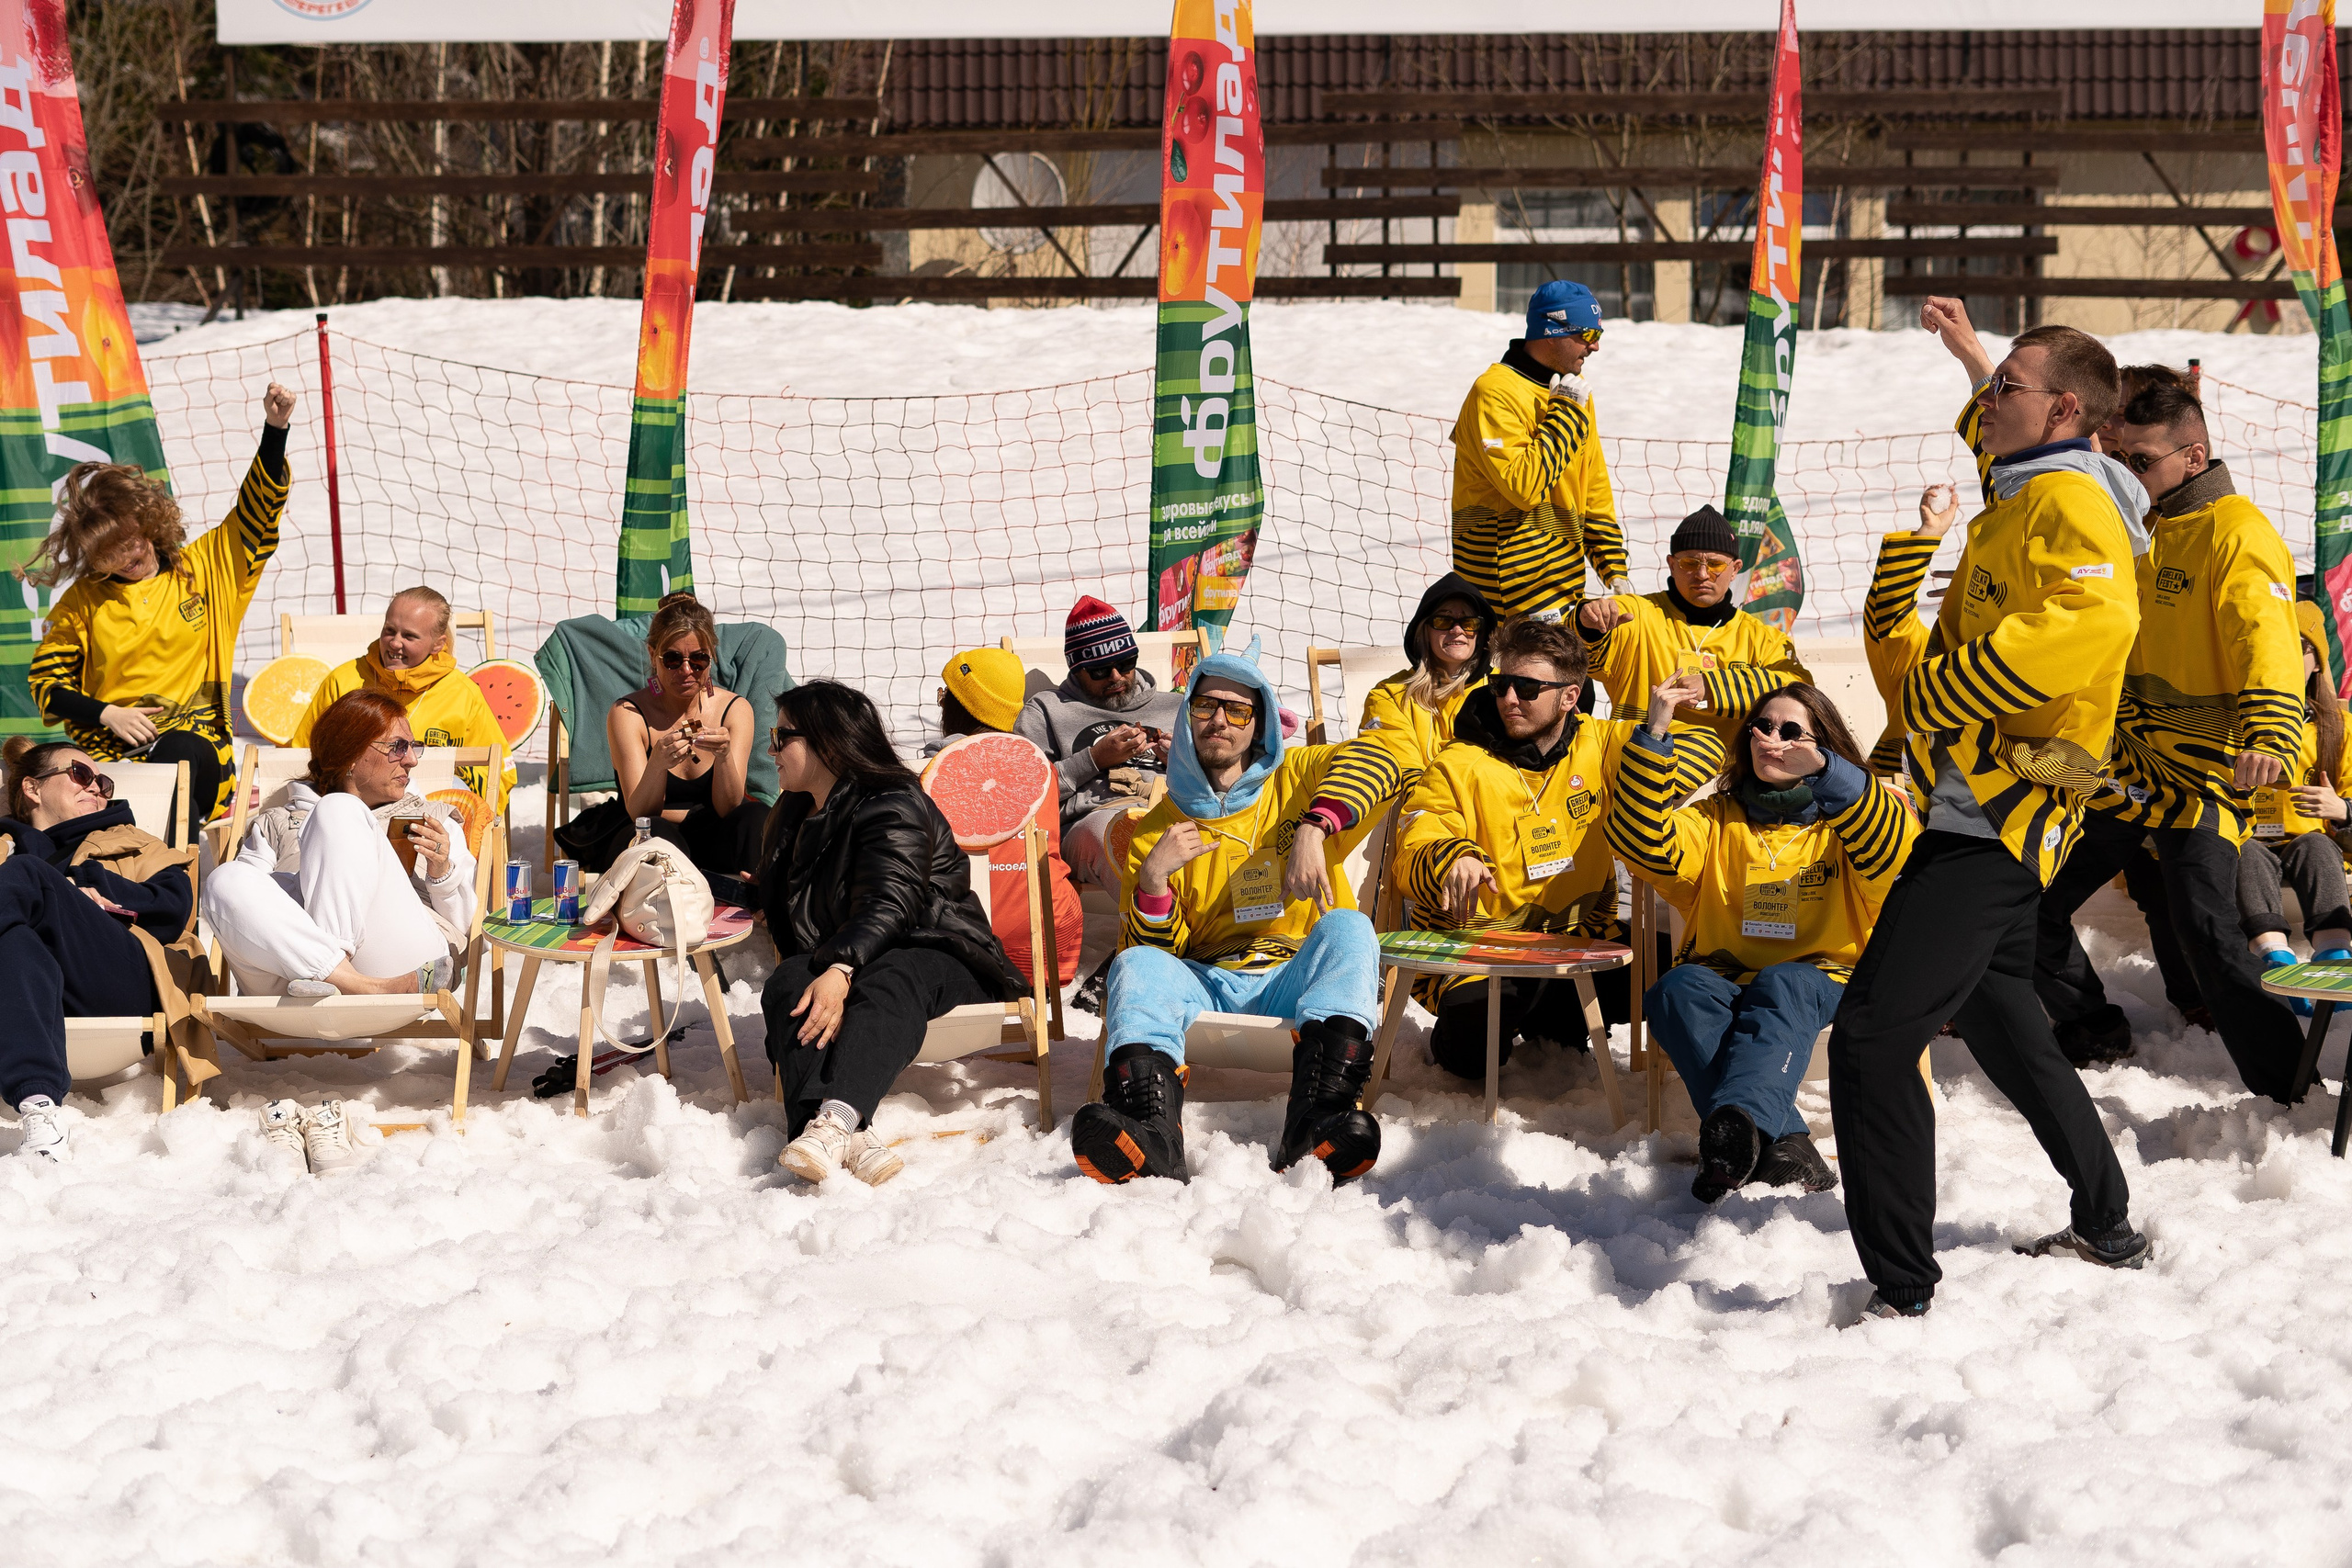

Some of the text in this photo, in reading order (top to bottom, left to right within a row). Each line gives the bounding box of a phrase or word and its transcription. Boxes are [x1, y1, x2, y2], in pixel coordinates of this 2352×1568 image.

[2162, 570, 2183, 581] GRELKA
[2159, 579, 2174, 589] FEST
[1082, 635, 1133, 660] СПИРТ
[1091, 724, 1109, 735] THE
[1531, 840, 1561, 854] ВОЛОНТЕР
[1801, 875, 1817, 885] FEST
[1240, 885, 1273, 897] ВОЛОНТЕР
[1753, 901, 1788, 911] ВОЛОНТЕР
